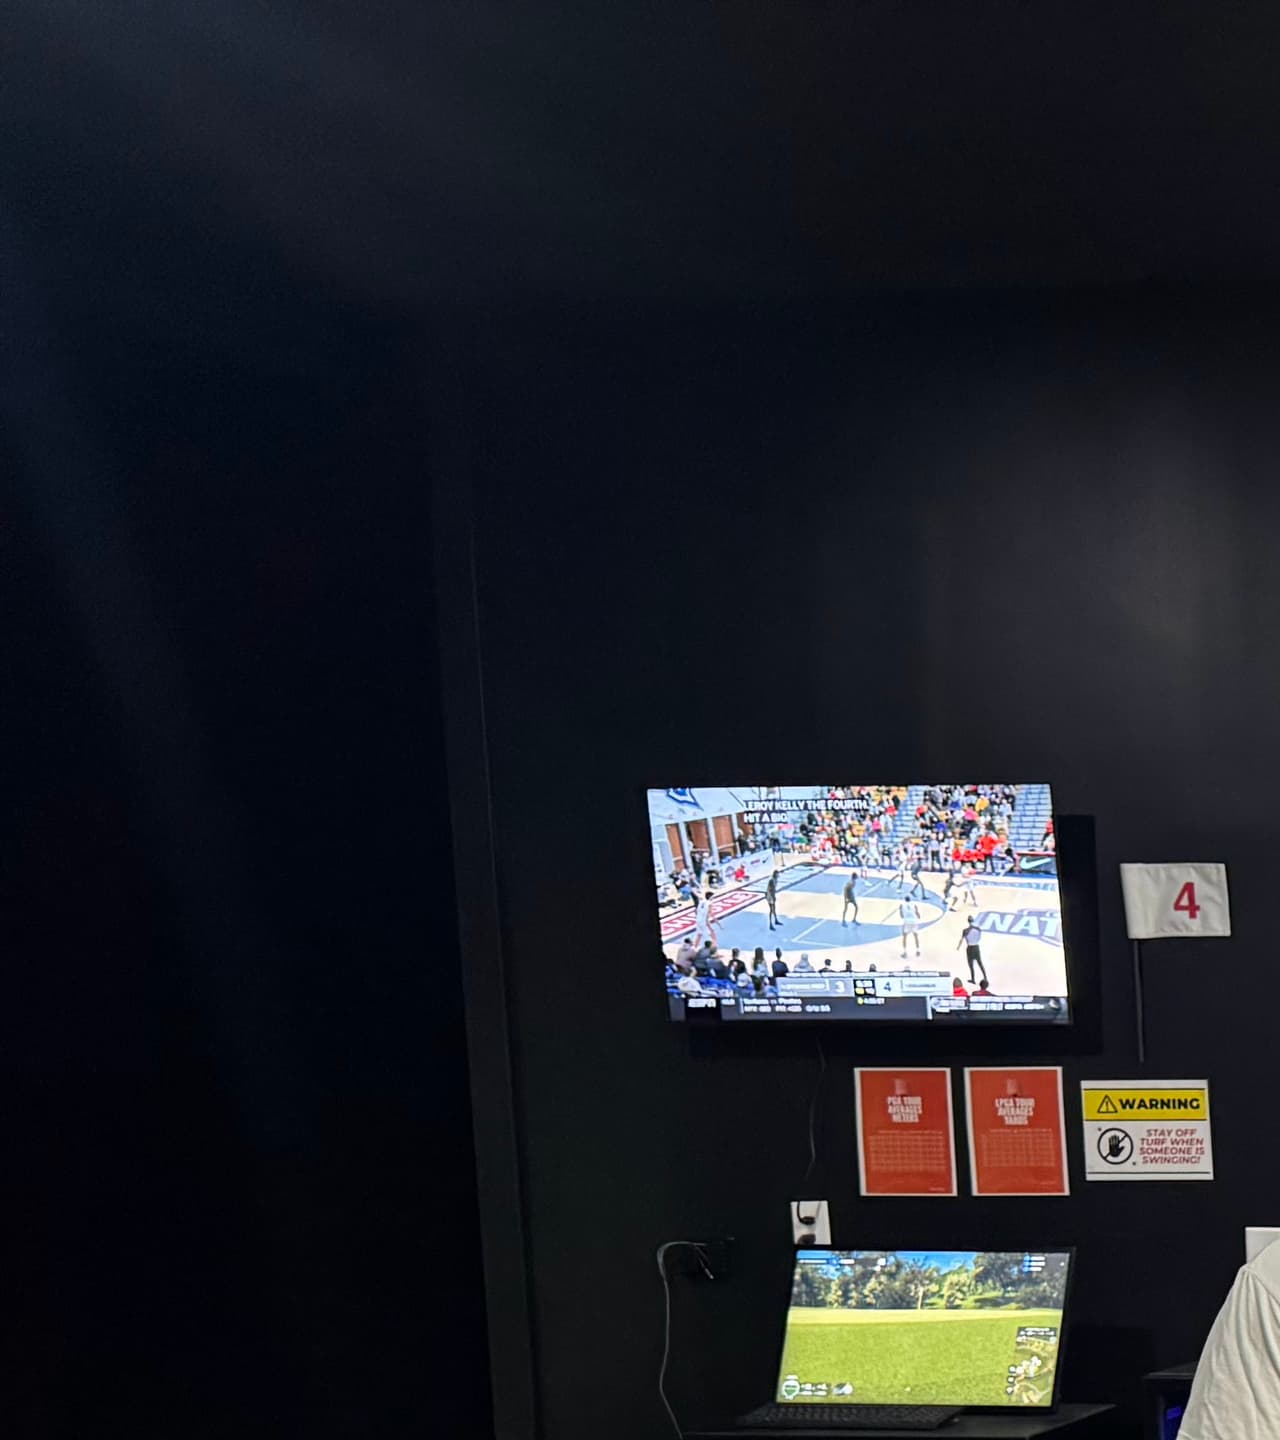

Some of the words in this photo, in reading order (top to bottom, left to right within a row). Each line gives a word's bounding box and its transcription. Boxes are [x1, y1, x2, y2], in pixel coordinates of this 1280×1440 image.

[807, 800, 826, 810] THE
[743, 813, 761, 823] HIT
[1173, 881, 1201, 920] 4
[1119, 1098, 1200, 1110] WARNING
[1146, 1128, 1174, 1137] STAY
[1175, 1128, 1197, 1137] OFF
[1140, 1138, 1168, 1146] TURF
[1170, 1138, 1204, 1146] WHEN
[1139, 1146, 1192, 1155] SOMEONE
[1195, 1146, 1205, 1155] IS
[1142, 1156, 1201, 1165] SWINGING!
